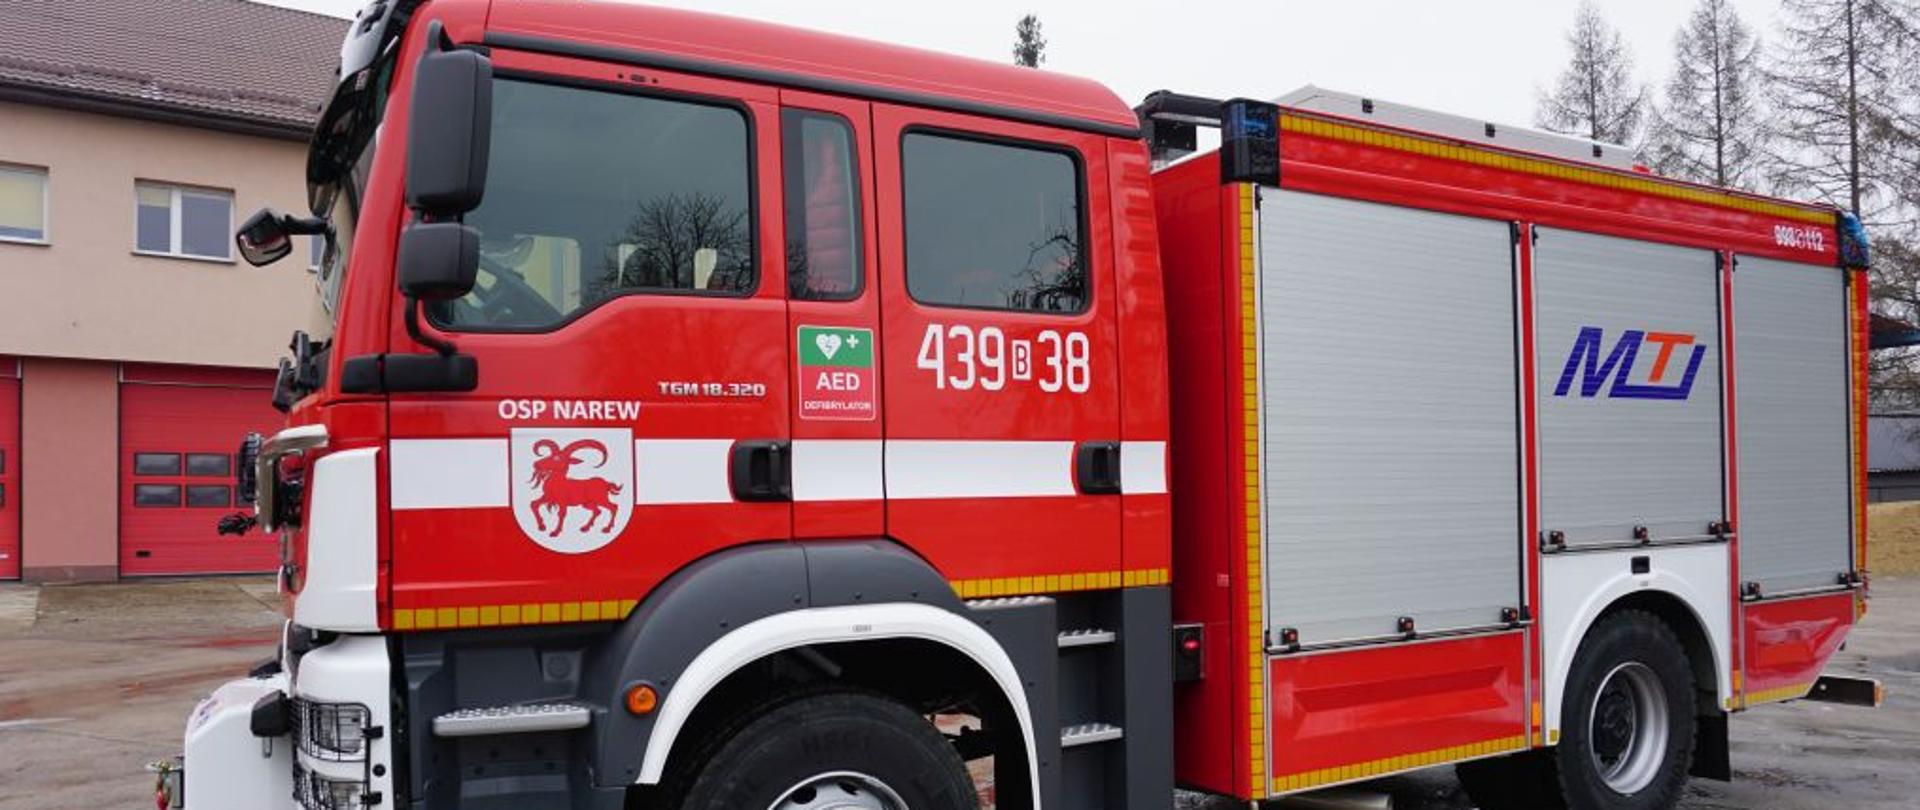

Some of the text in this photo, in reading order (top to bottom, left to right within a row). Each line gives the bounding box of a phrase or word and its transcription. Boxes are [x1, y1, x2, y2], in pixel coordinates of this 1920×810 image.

[1806, 230, 1825, 251] 112
[657, 381, 766, 397] TGM 18.320
[816, 371, 860, 391] AED
[498, 400, 641, 420] OSP NAREW
[804, 401, 872, 411] DEFIBRYLATOR
